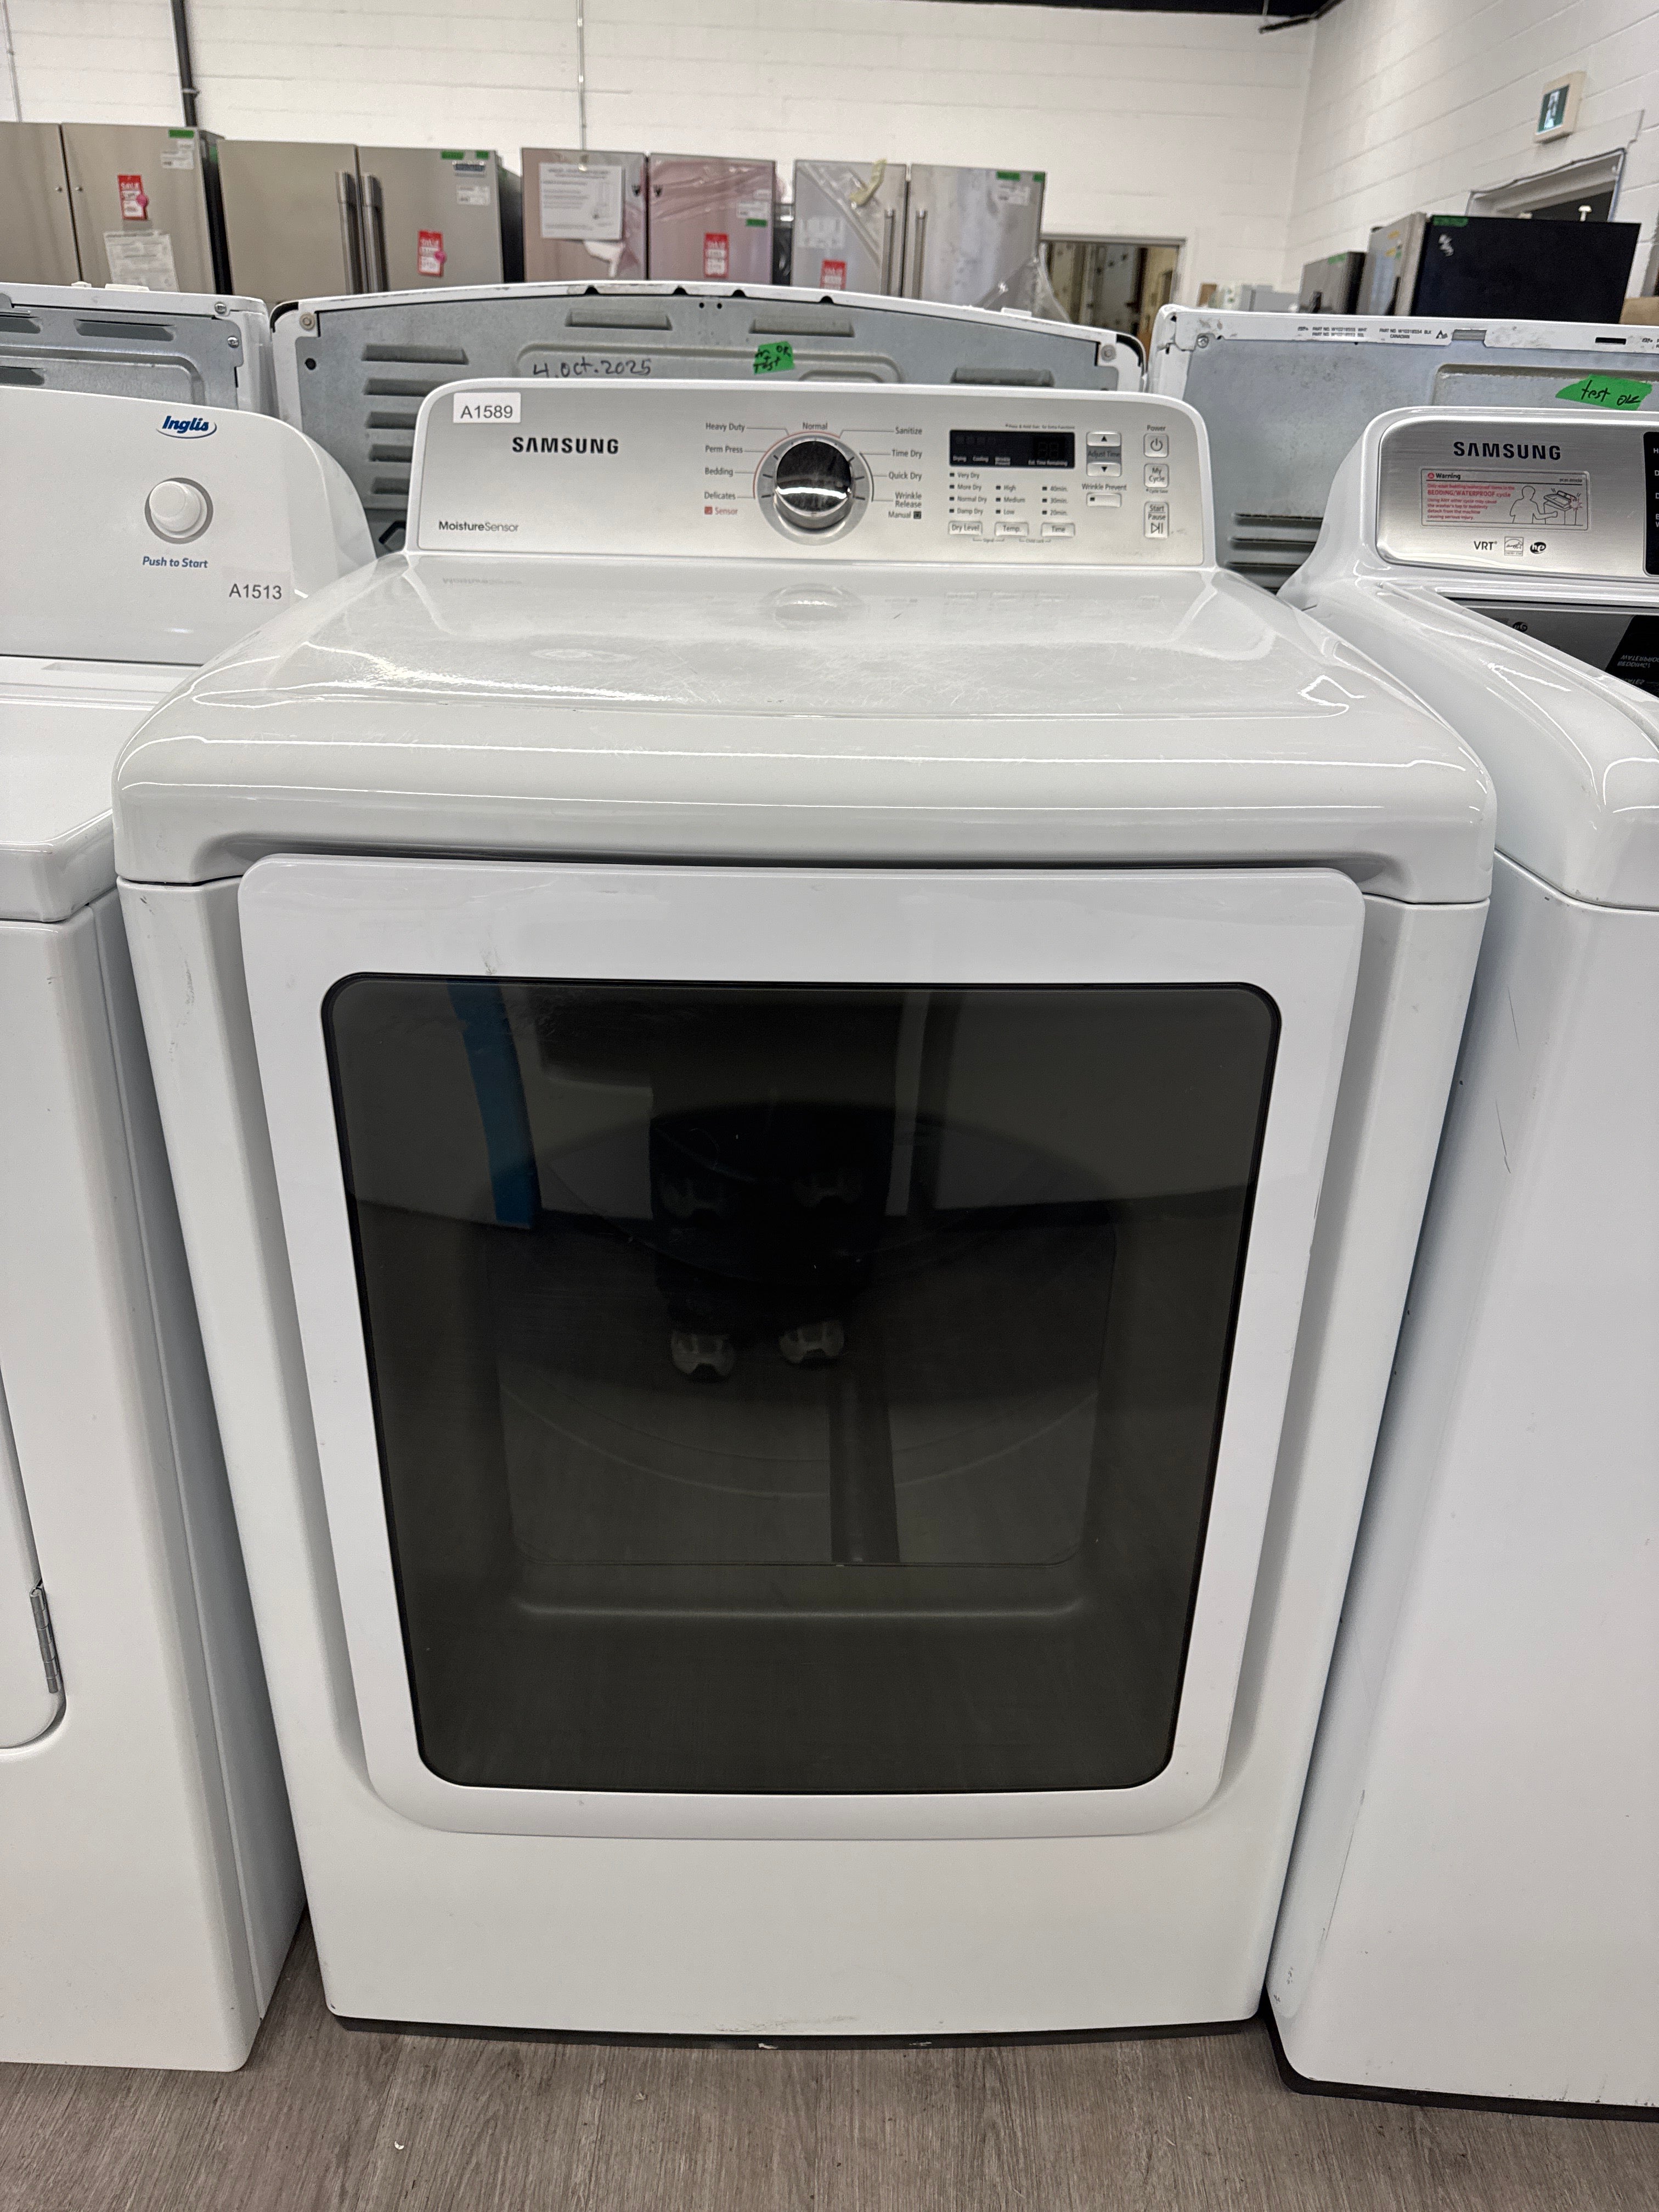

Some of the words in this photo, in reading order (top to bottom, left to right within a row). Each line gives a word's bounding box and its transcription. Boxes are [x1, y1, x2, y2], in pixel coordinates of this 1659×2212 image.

[1581, 380, 1611, 402] test
[461, 405, 512, 419] A1589
[162, 416, 209, 433] Inglis
[706, 422, 727, 432] Heavy
[729, 423, 745, 433] Duty
[895, 426, 922, 435] Sanitize
[512, 437, 619, 454] SAMSUNG
[1454, 441, 1561, 460] SAMSUNG
[911, 449, 922, 459] Dry
[1088, 450, 1105, 459] Adjust
[705, 467, 733, 477] Bedding
[888, 471, 908, 479] Quick
[910, 472, 922, 482] Dry
[704, 491, 736, 500] Delicates
[895, 492, 922, 500] Wrinkle
[715, 506, 738, 515] Sensor
[439, 521, 518, 532] MoistureSensor
[952, 524, 962, 533] Dry
[143, 556, 167, 567] Push
[170, 558, 179, 567] to
[182, 558, 208, 568] Start
[229, 584, 282, 600] A1513
